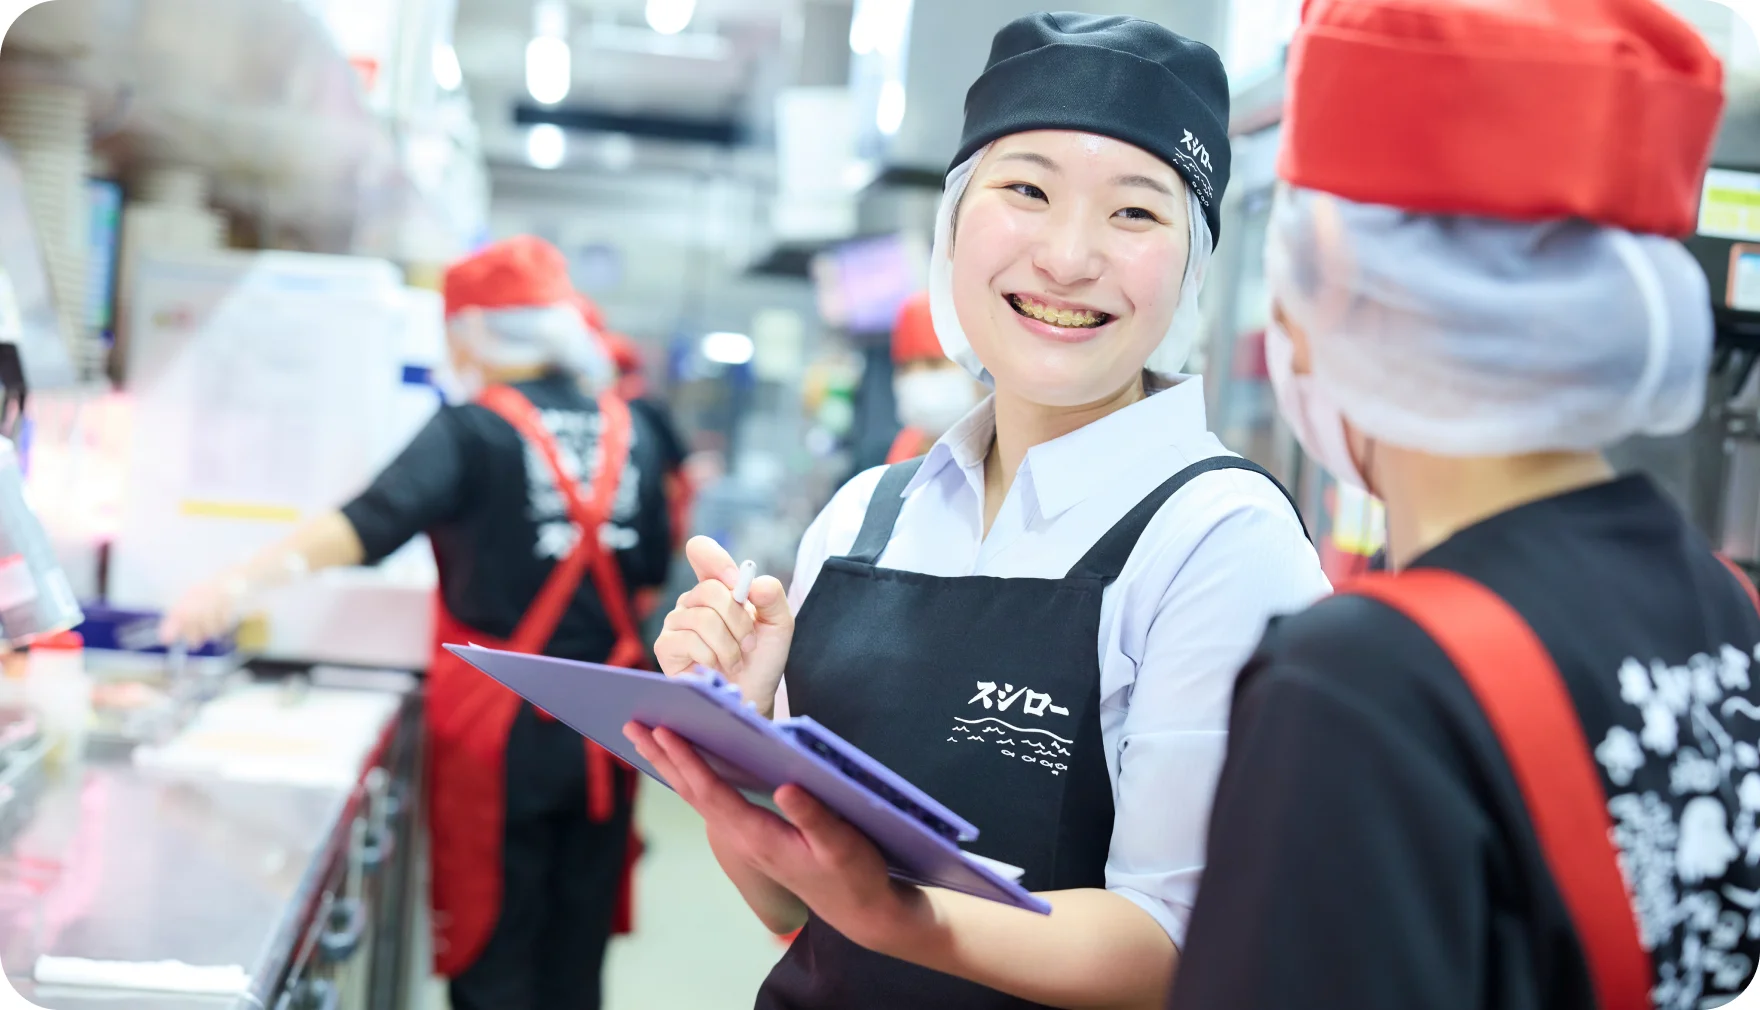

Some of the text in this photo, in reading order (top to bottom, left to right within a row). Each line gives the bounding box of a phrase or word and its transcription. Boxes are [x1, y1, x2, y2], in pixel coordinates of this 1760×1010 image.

[1180, 128, 1213, 173] スシロー
[967, 680, 1070, 717] スシロー
